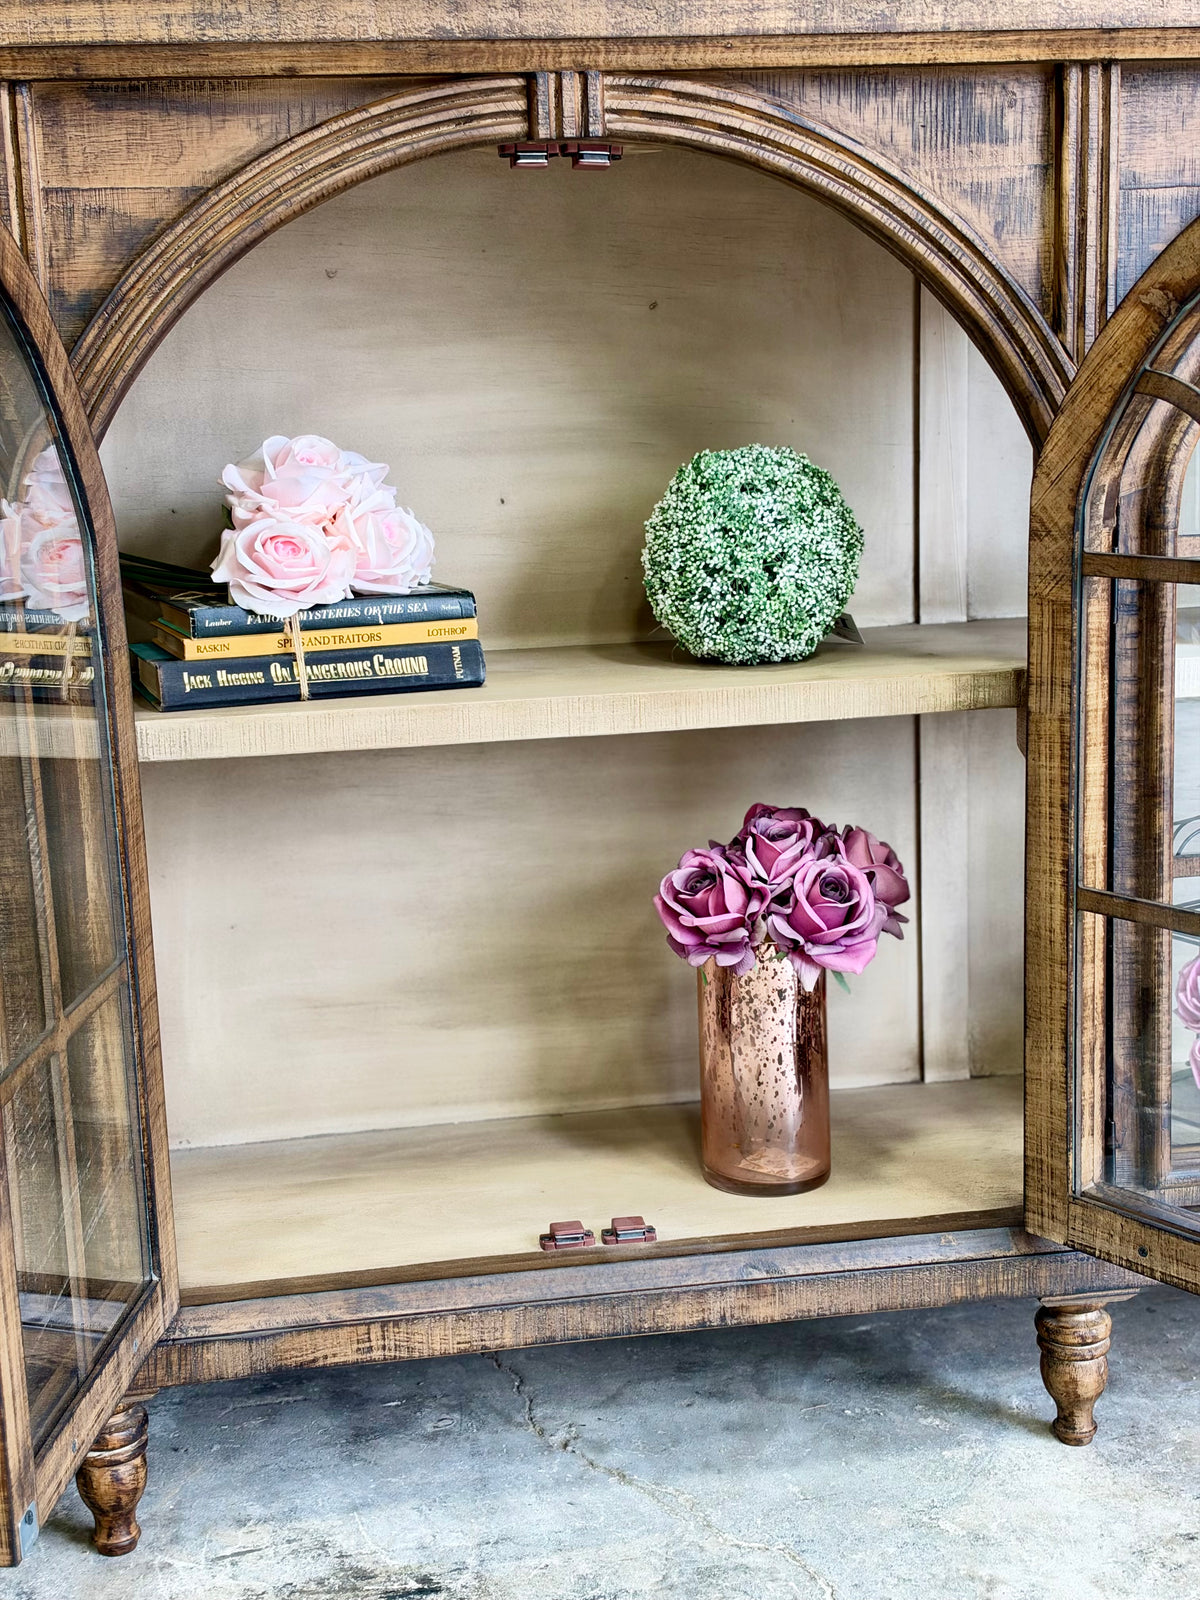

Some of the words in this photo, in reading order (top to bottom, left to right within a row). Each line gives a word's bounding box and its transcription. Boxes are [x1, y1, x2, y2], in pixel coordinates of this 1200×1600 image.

[298, 606, 361, 621] MYSTERIES
[381, 603, 405, 615] THE
[407, 602, 429, 613] SEA
[306, 635, 331, 646] AND
[331, 632, 382, 645] TRAITORS
[427, 626, 467, 637] LOTHROP
[196, 643, 230, 653] RASKIN
[270, 662, 292, 683] ON
[373, 654, 429, 677] GROUND
[451, 646, 464, 679] PUTNAM
[183, 671, 213, 693] JACK
[216, 669, 265, 687] HIGGINS
